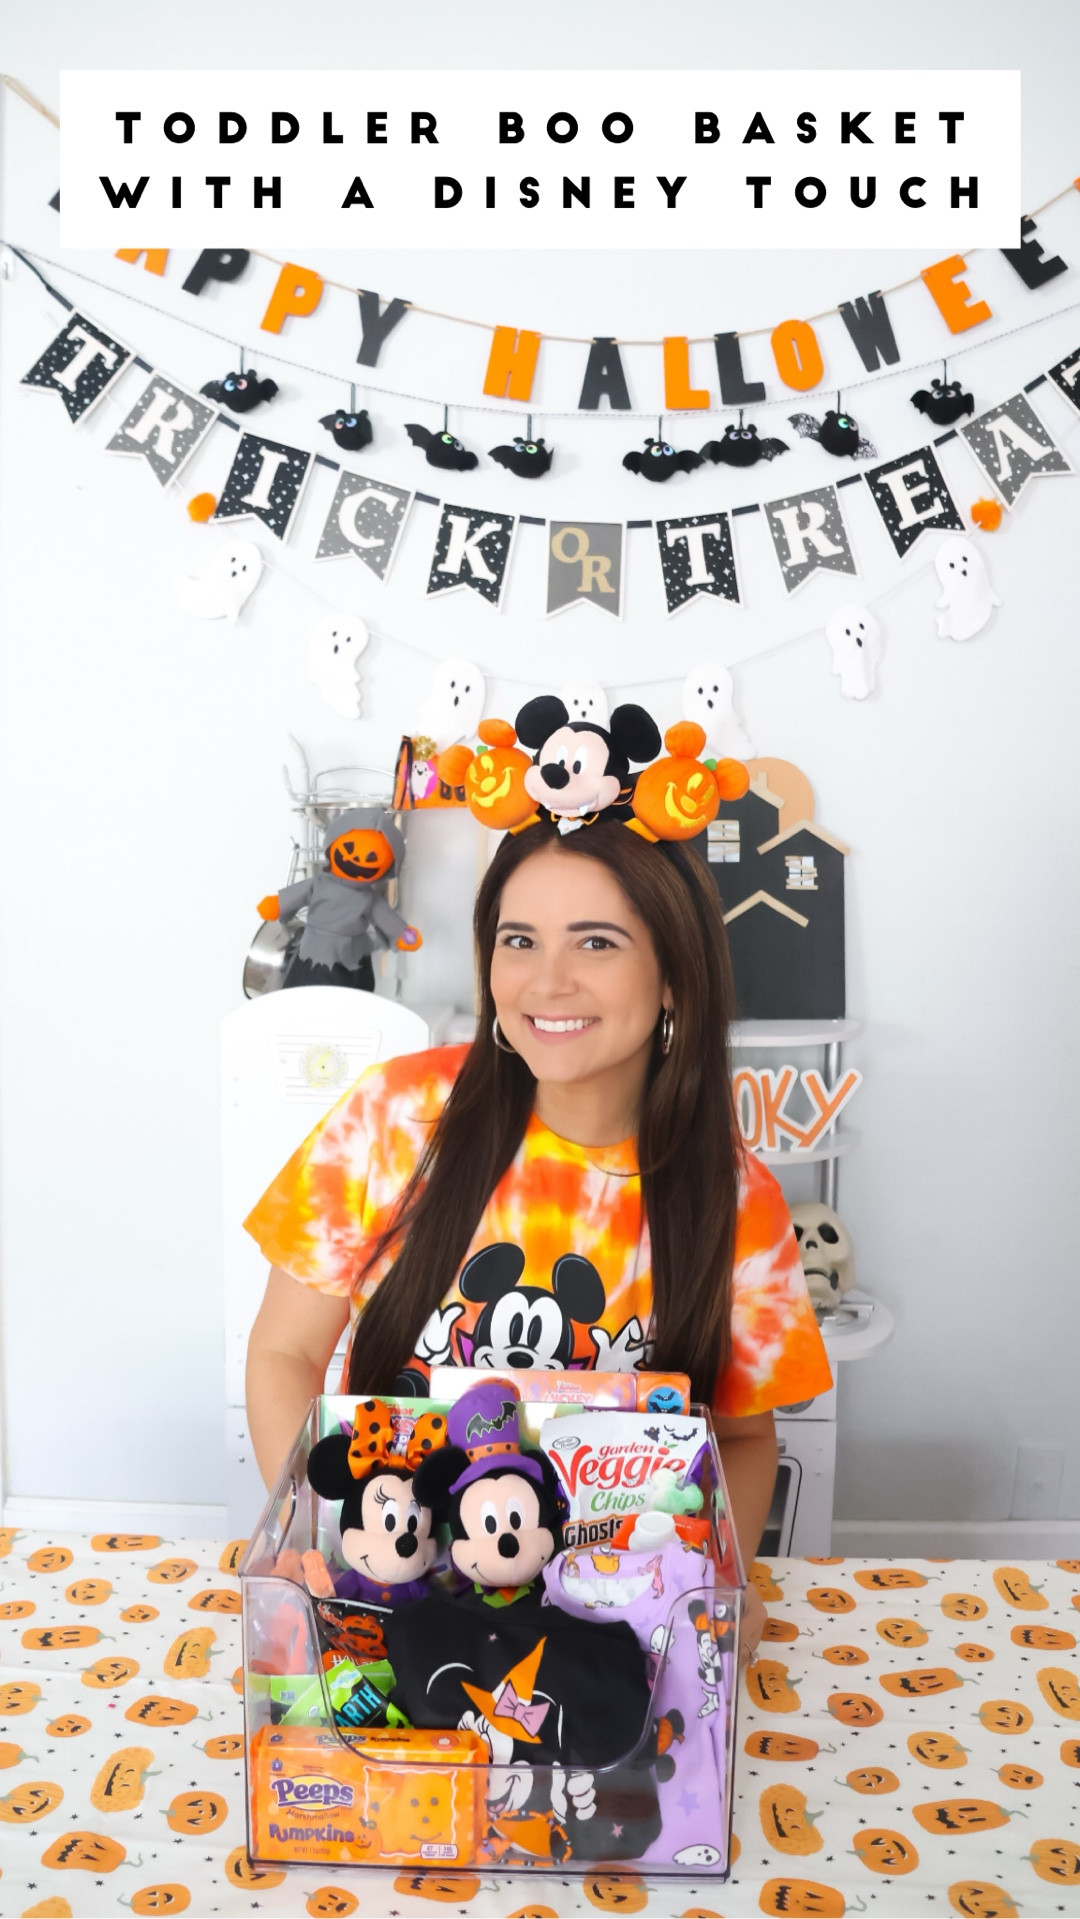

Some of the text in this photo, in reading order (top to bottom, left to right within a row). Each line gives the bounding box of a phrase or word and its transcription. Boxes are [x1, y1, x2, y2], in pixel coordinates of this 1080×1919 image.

[483, 176, 1080, 411] HALLOWEE
[52, 324, 1080, 594] TRICK OR TREA
[599, 1442, 654, 1460] garden
[590, 1490, 645, 1512] Chips
[322, 1684, 381, 1728] ARTH
[271, 1779, 354, 1806] Peeps
[286, 1809, 340, 1821] Marshmallow
